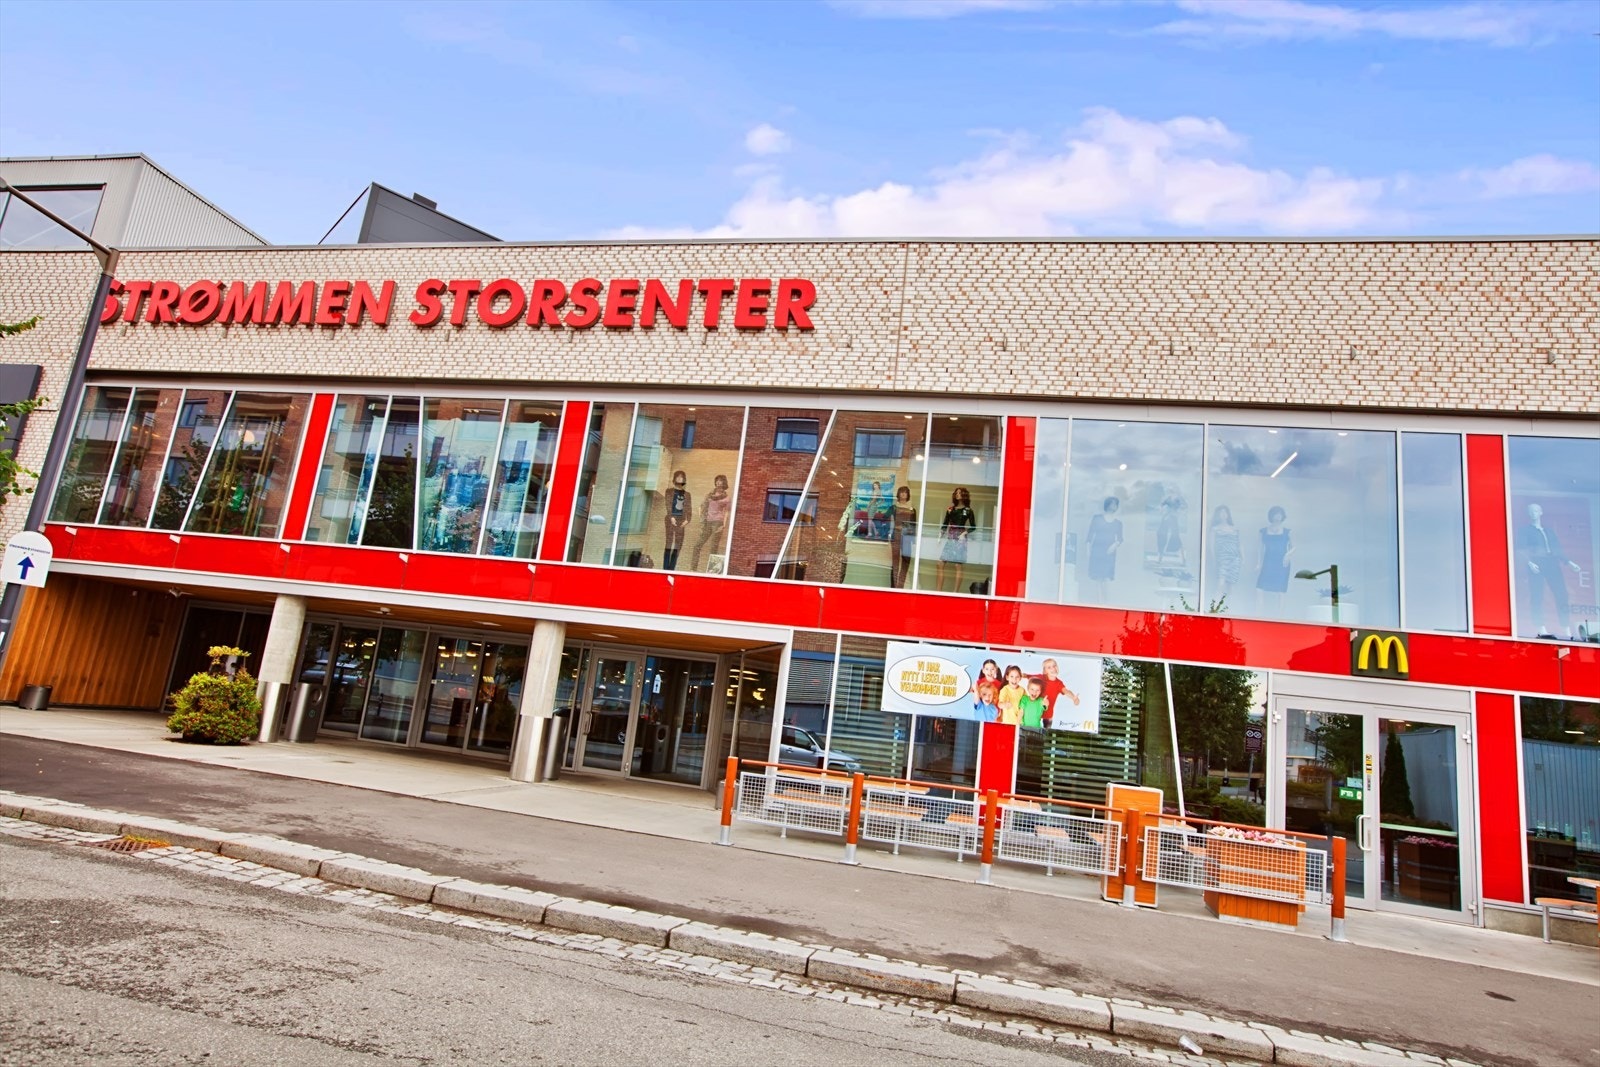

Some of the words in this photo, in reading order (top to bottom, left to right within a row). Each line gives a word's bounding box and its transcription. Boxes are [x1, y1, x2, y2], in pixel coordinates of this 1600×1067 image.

[408, 277, 817, 330] STORSENTER
[918, 661, 924, 671] VI
[926, 662, 940, 673] HAR
[901, 671, 920, 682] NYTT
[921, 673, 957, 686] LEKELAND!
[900, 682, 940, 695] VELKOMMEN
